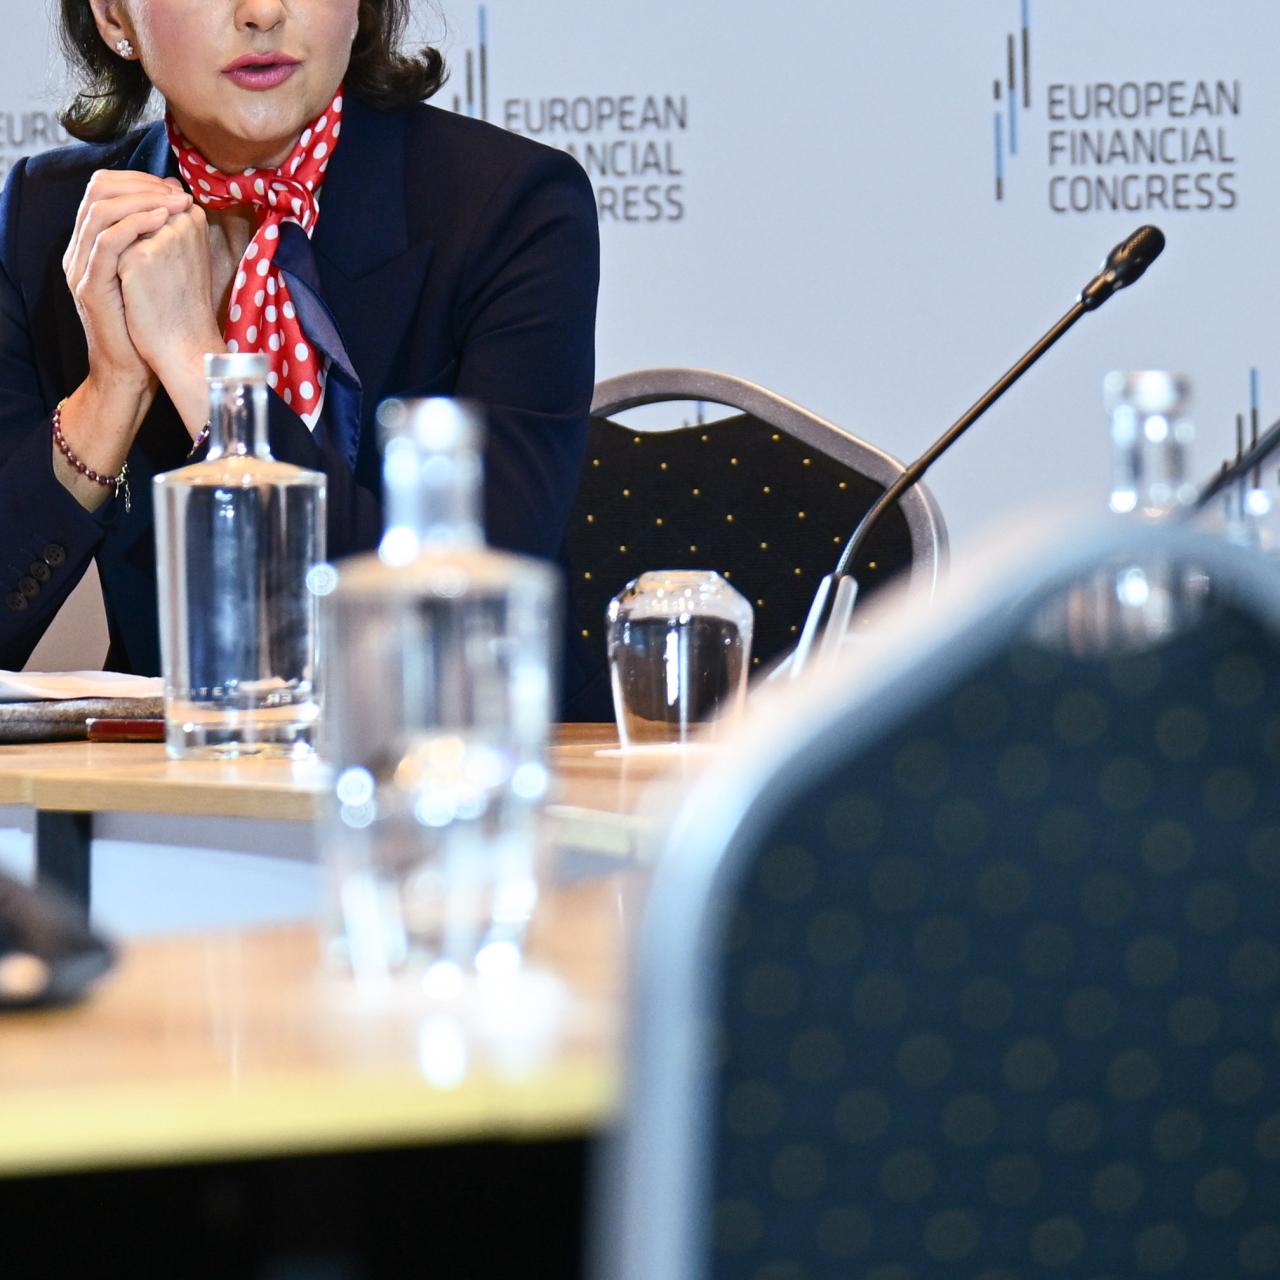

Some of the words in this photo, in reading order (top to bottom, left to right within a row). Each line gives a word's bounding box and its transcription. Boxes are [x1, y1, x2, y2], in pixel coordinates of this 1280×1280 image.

[503, 95, 688, 135] EUROPEAN
[1047, 80, 1241, 122] EUROPEAN
[584, 141, 684, 178] NCIAL
[1048, 126, 1237, 167] FINANCIAL
[597, 184, 686, 223] RESS
[1048, 172, 1238, 214] CONGRESS
